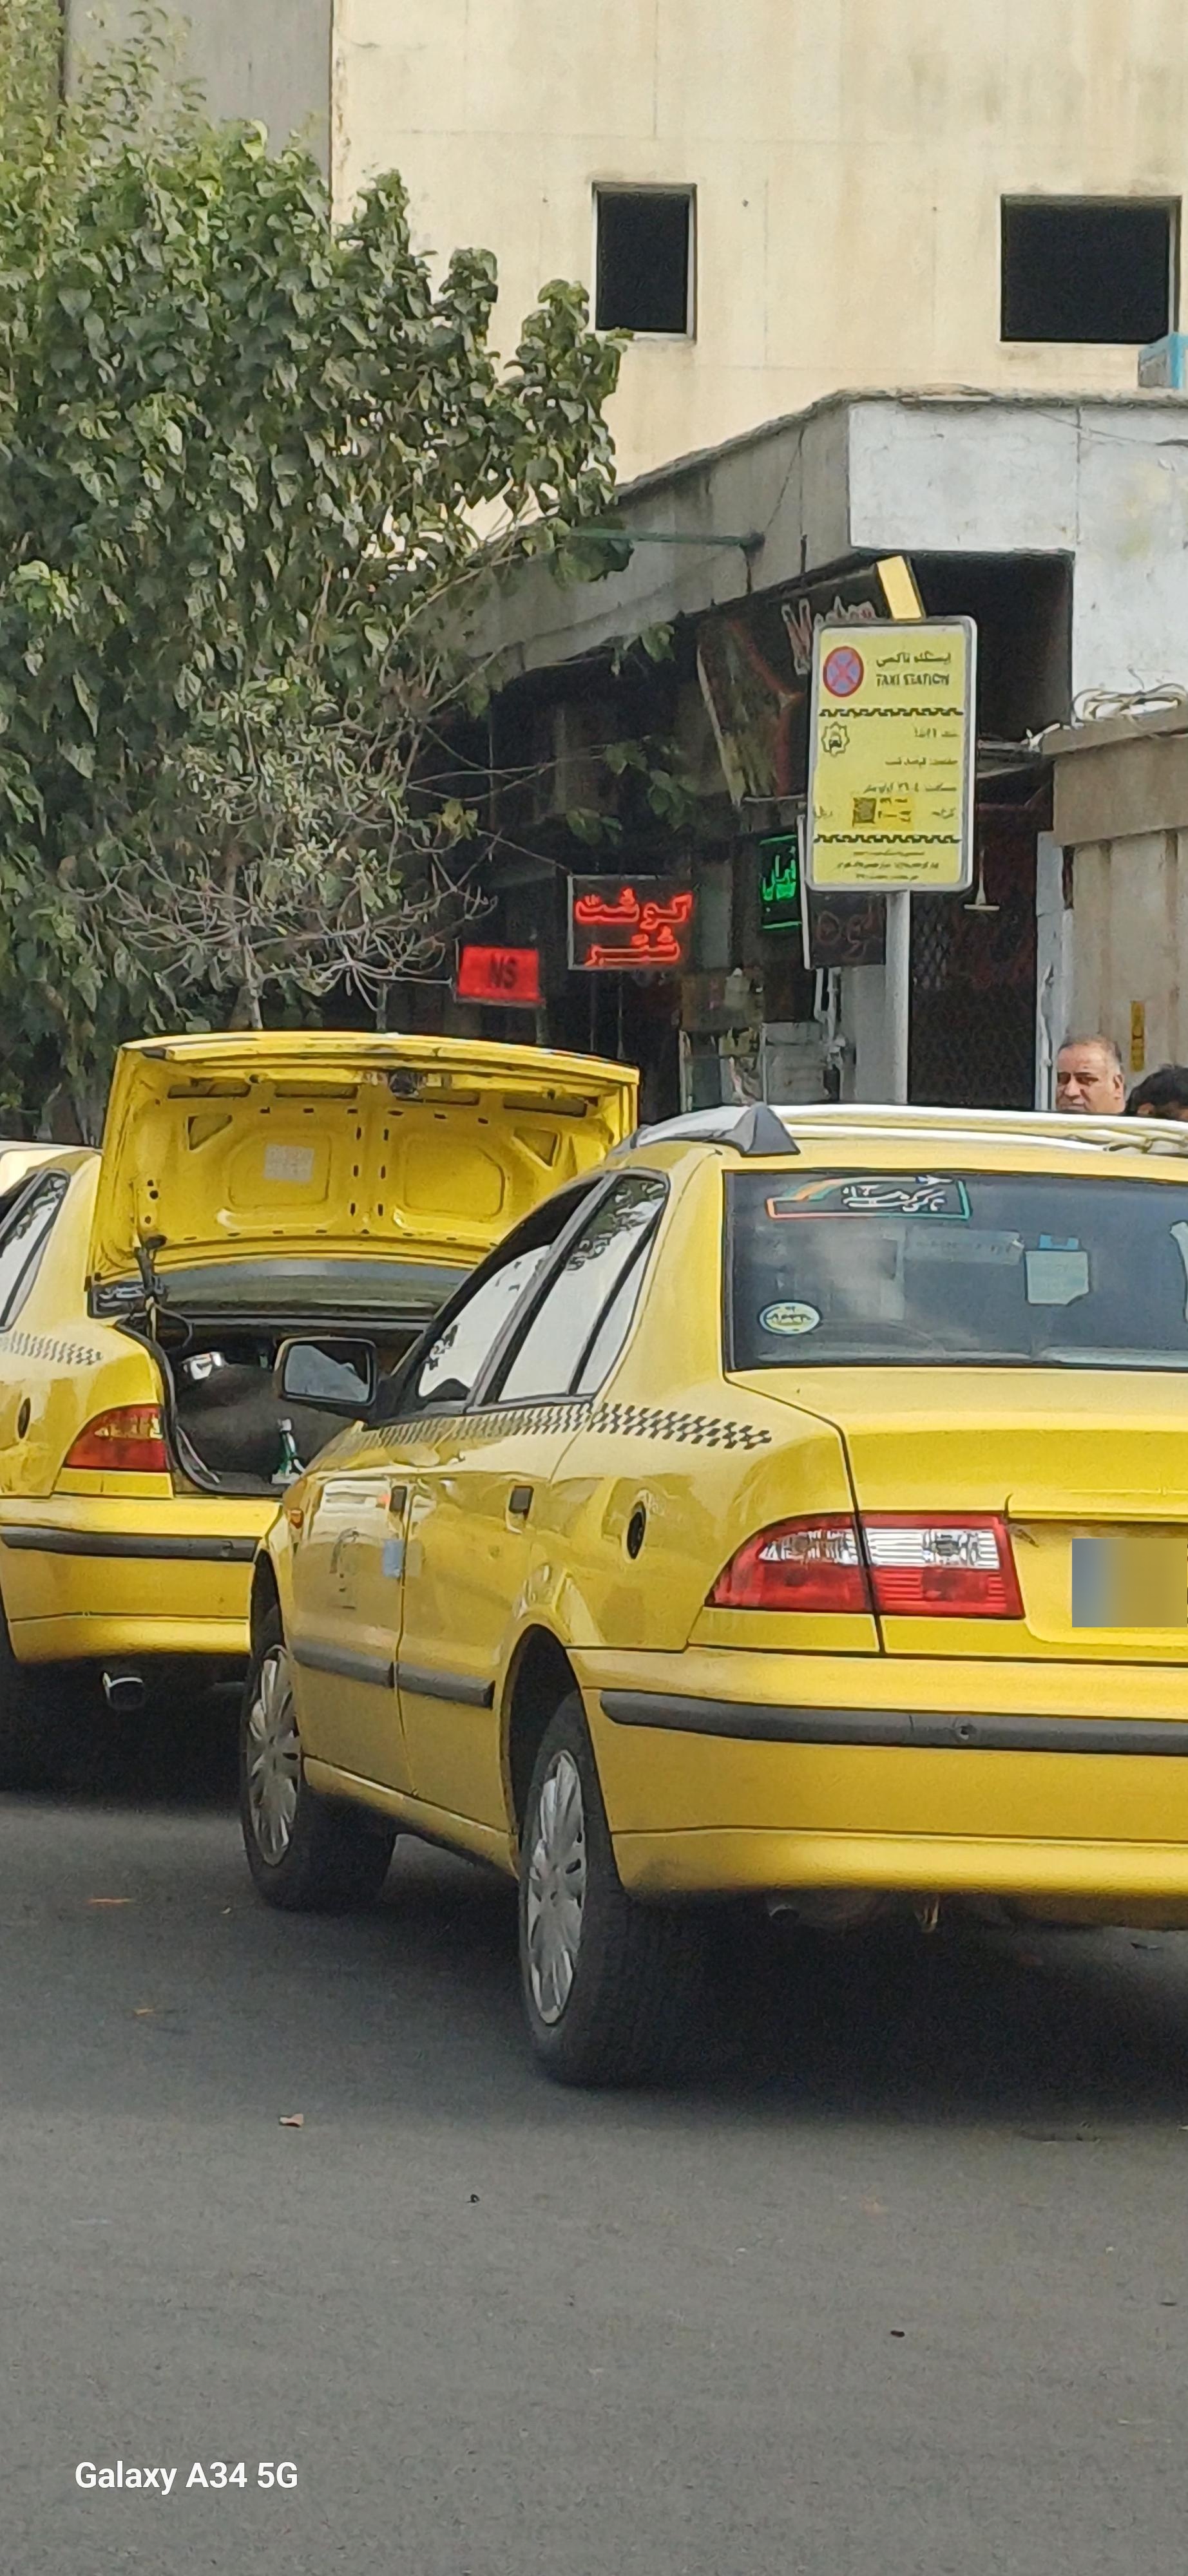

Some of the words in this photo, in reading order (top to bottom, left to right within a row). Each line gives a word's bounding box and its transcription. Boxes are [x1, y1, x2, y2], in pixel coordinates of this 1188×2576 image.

[876, 674, 900, 687] TAXI
[903, 673, 950, 686] STATION
[584, 925, 682, 967] شتر
